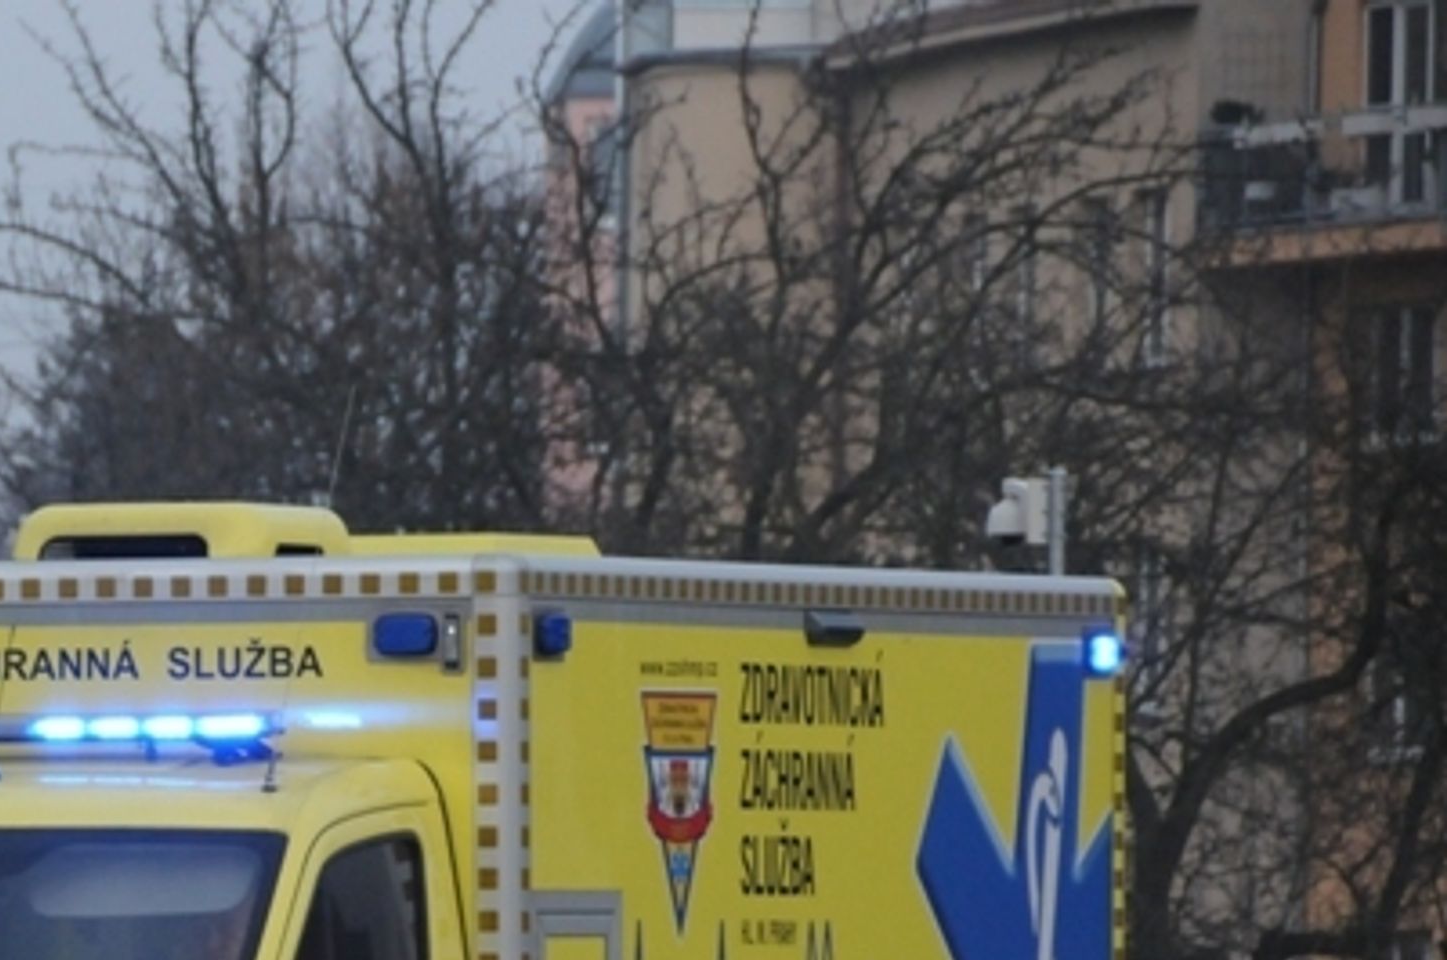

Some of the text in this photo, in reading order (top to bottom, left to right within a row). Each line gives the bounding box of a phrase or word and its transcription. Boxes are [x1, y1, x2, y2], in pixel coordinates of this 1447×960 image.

[166, 637, 324, 680] SLUŽBA
[740, 649, 885, 728] ZDRAVOTNICKÁ
[740, 731, 856, 811] ZÁCHRANNÁ
[740, 817, 815, 896] SLUŽBA
